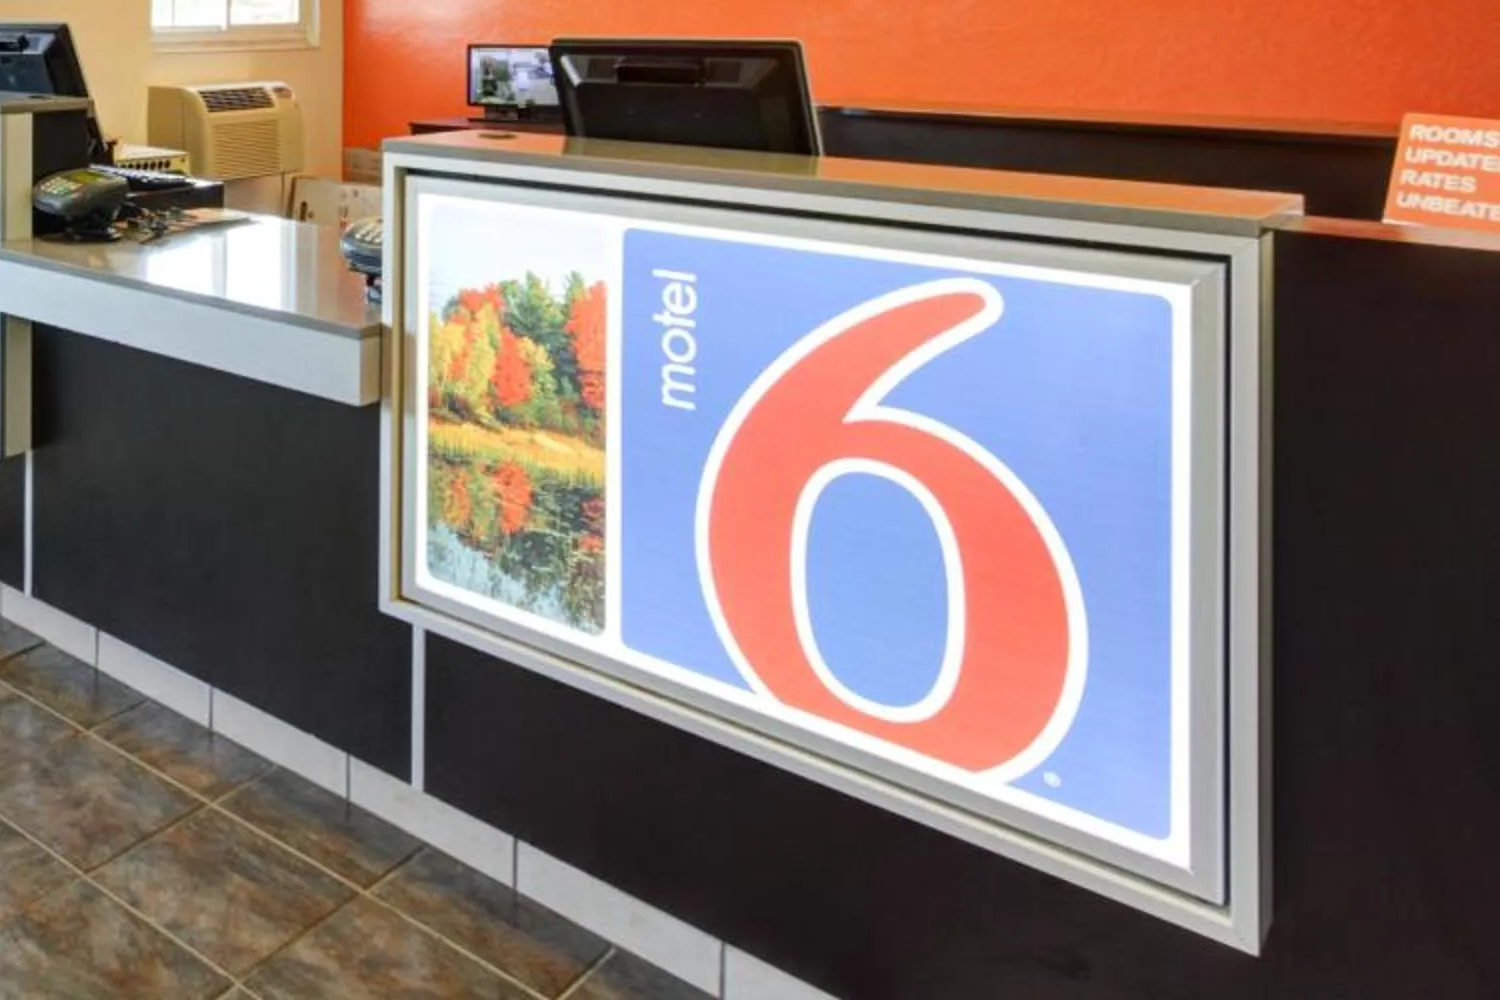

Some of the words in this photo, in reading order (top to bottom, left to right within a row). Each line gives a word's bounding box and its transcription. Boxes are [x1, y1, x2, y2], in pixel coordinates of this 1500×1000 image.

[1409, 123, 1500, 148] ROOMS
[1400, 168, 1477, 193] RATES
[652, 268, 698, 411] motel
[695, 277, 1090, 785] 6
